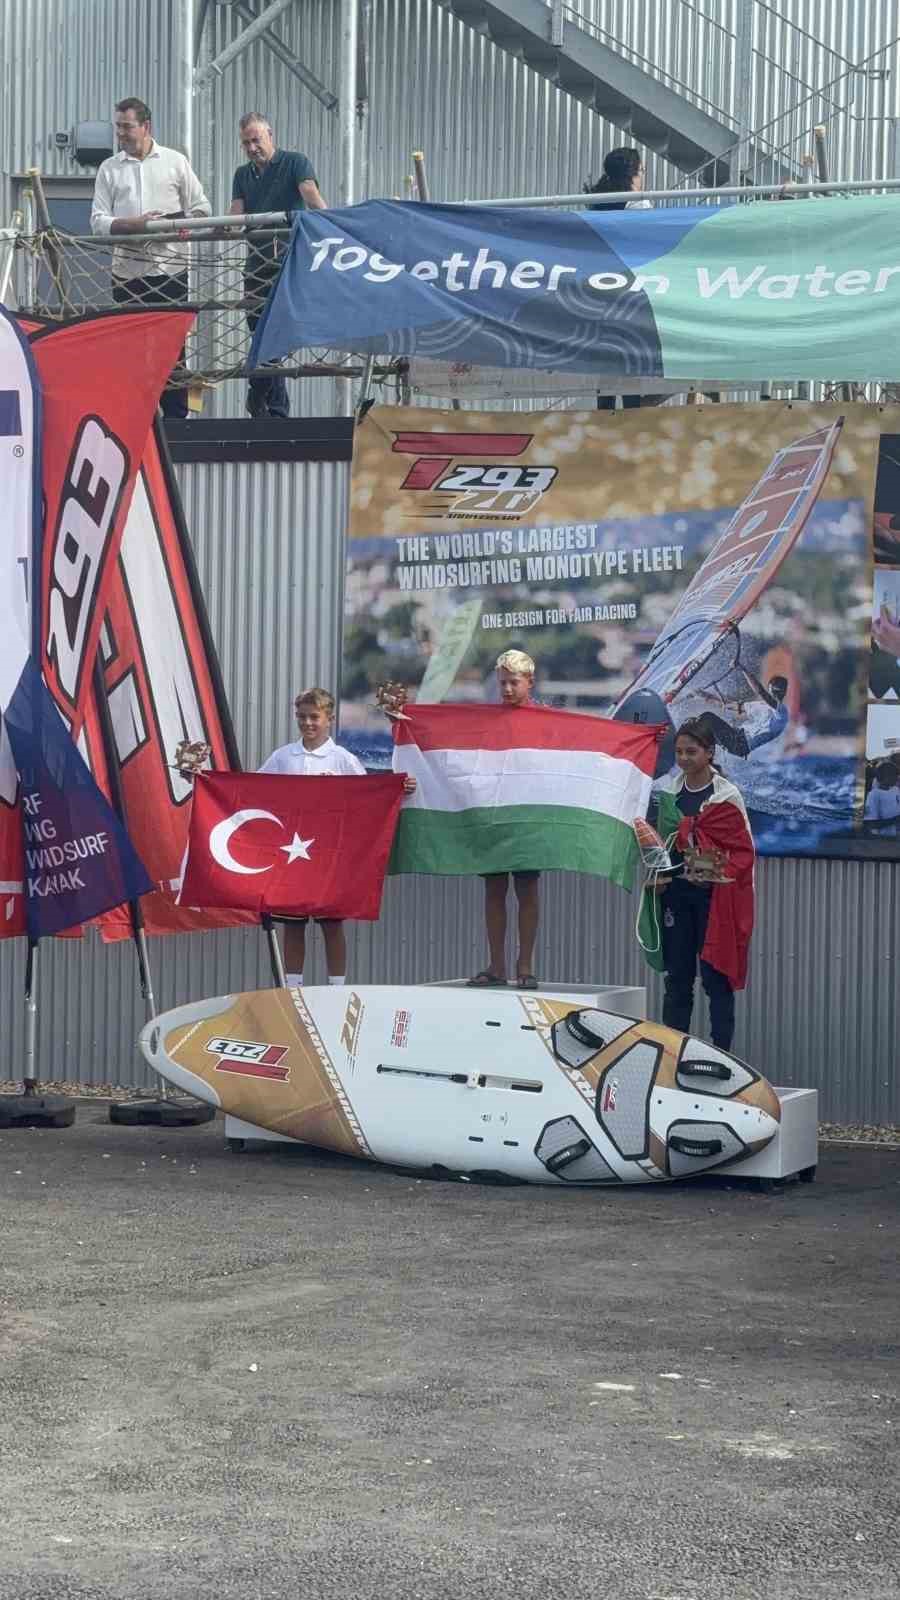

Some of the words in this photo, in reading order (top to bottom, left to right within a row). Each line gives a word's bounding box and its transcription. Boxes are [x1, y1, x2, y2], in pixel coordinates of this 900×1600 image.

[310, 237, 576, 291] Together
[588, 271, 670, 294] on
[696, 264, 900, 299] Water
[396, 536, 430, 562] THE
[434, 531, 512, 560] WORLD'S
[518, 524, 598, 552] LARGEST
[397, 559, 521, 590] WINDSURFING
[526, 550, 628, 580] MONOTYPE
[633, 545, 684, 573] FLEET
[482, 613, 502, 629] ONE
[505, 610, 544, 627] DESIGN
[546, 608, 569, 625] FOR
[569, 606, 593, 623] FAIR
[595, 603, 638, 621] RACING
